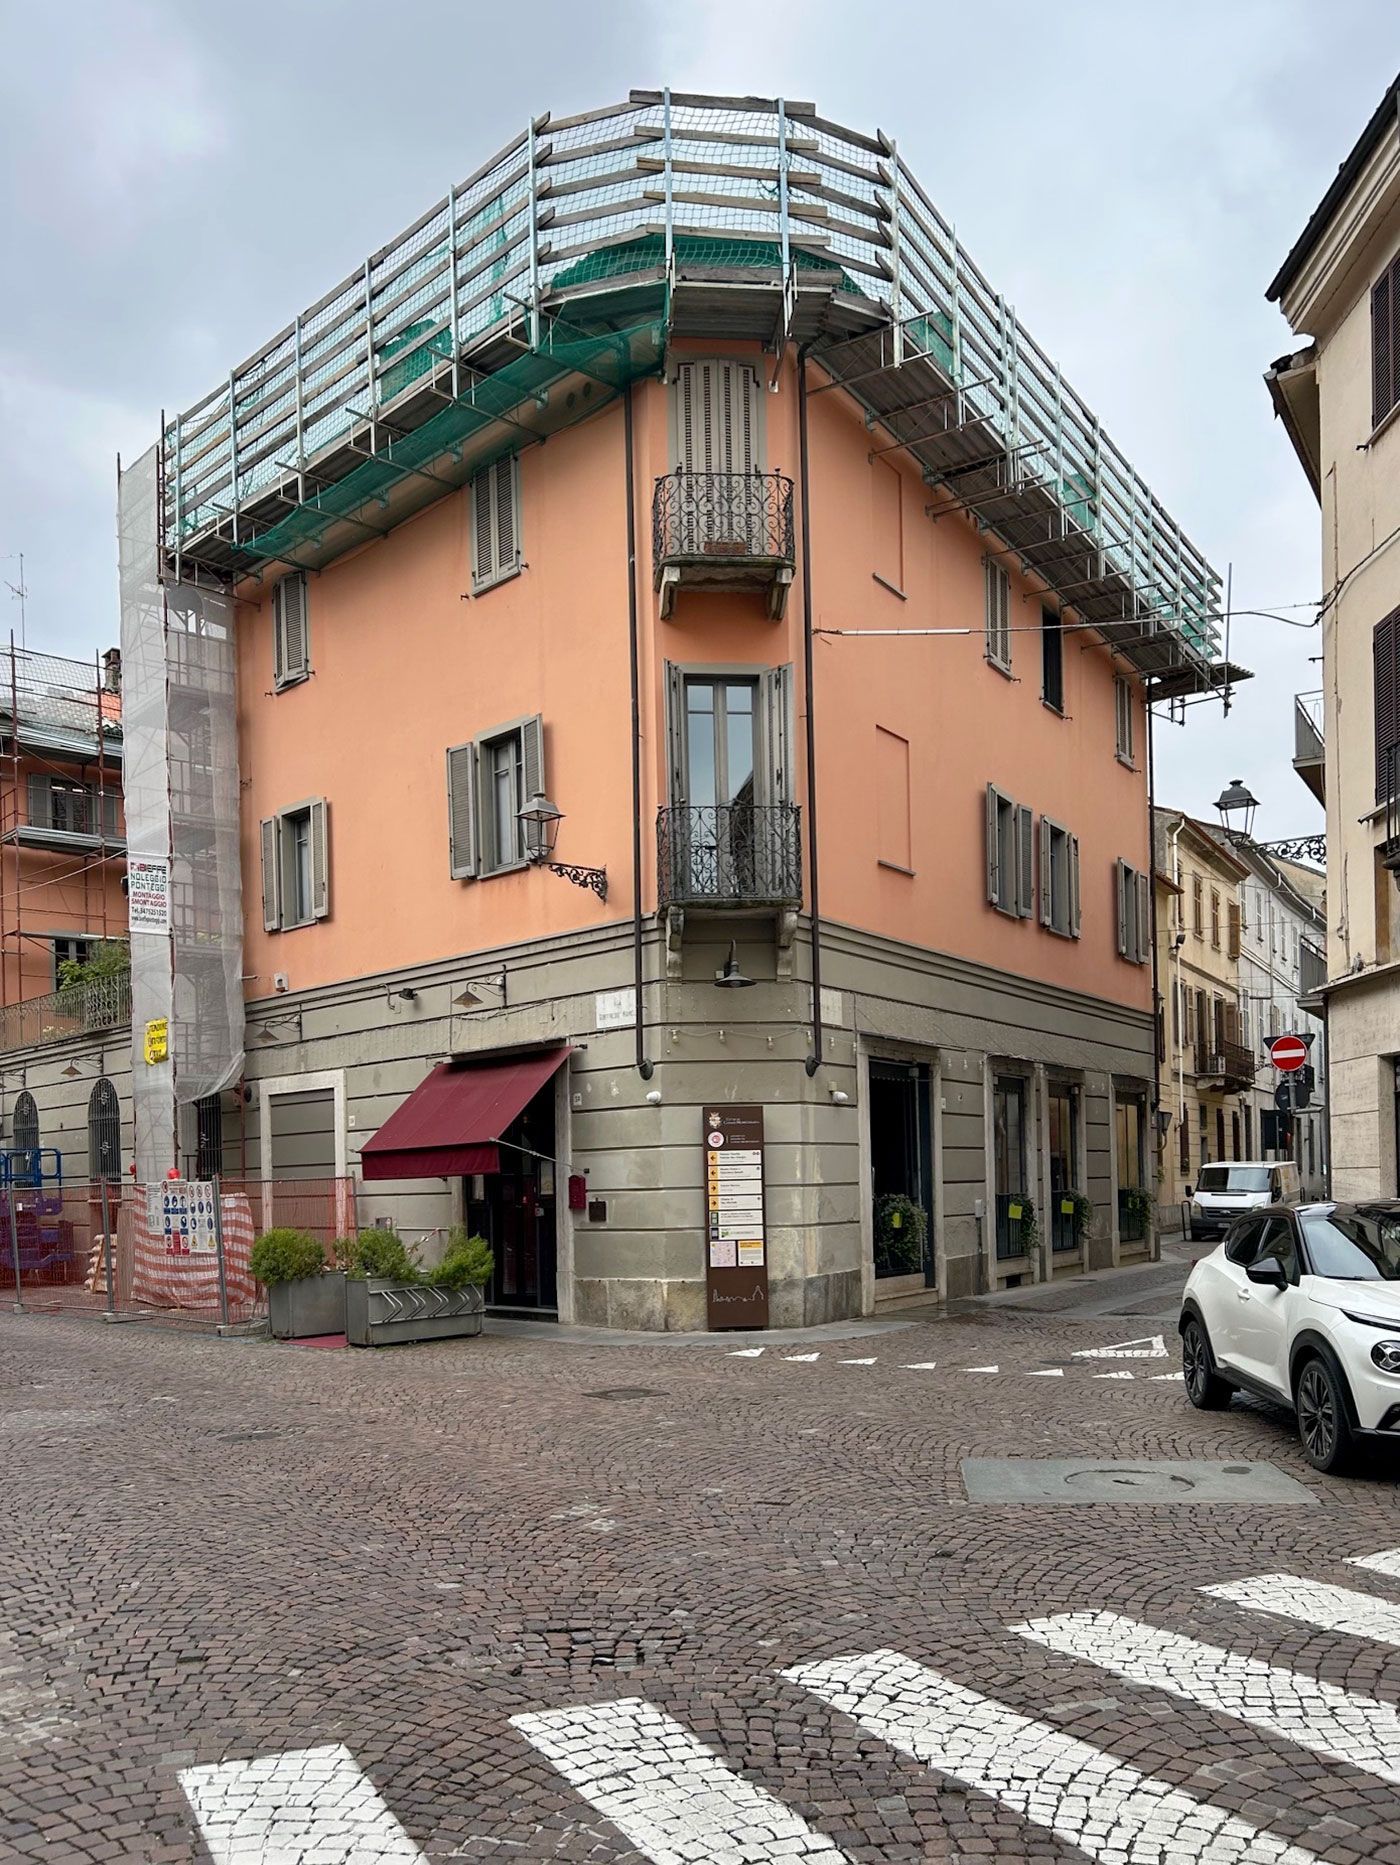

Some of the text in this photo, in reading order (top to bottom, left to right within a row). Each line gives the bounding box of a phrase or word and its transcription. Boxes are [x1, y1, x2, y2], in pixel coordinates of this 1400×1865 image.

[131, 873, 167, 883] NOLEGGIO
[131, 881, 167, 892] PONTEGGI
[132, 891, 166, 900] MONTAGGIO
[131, 898, 167, 908] SMONTAGGIO
